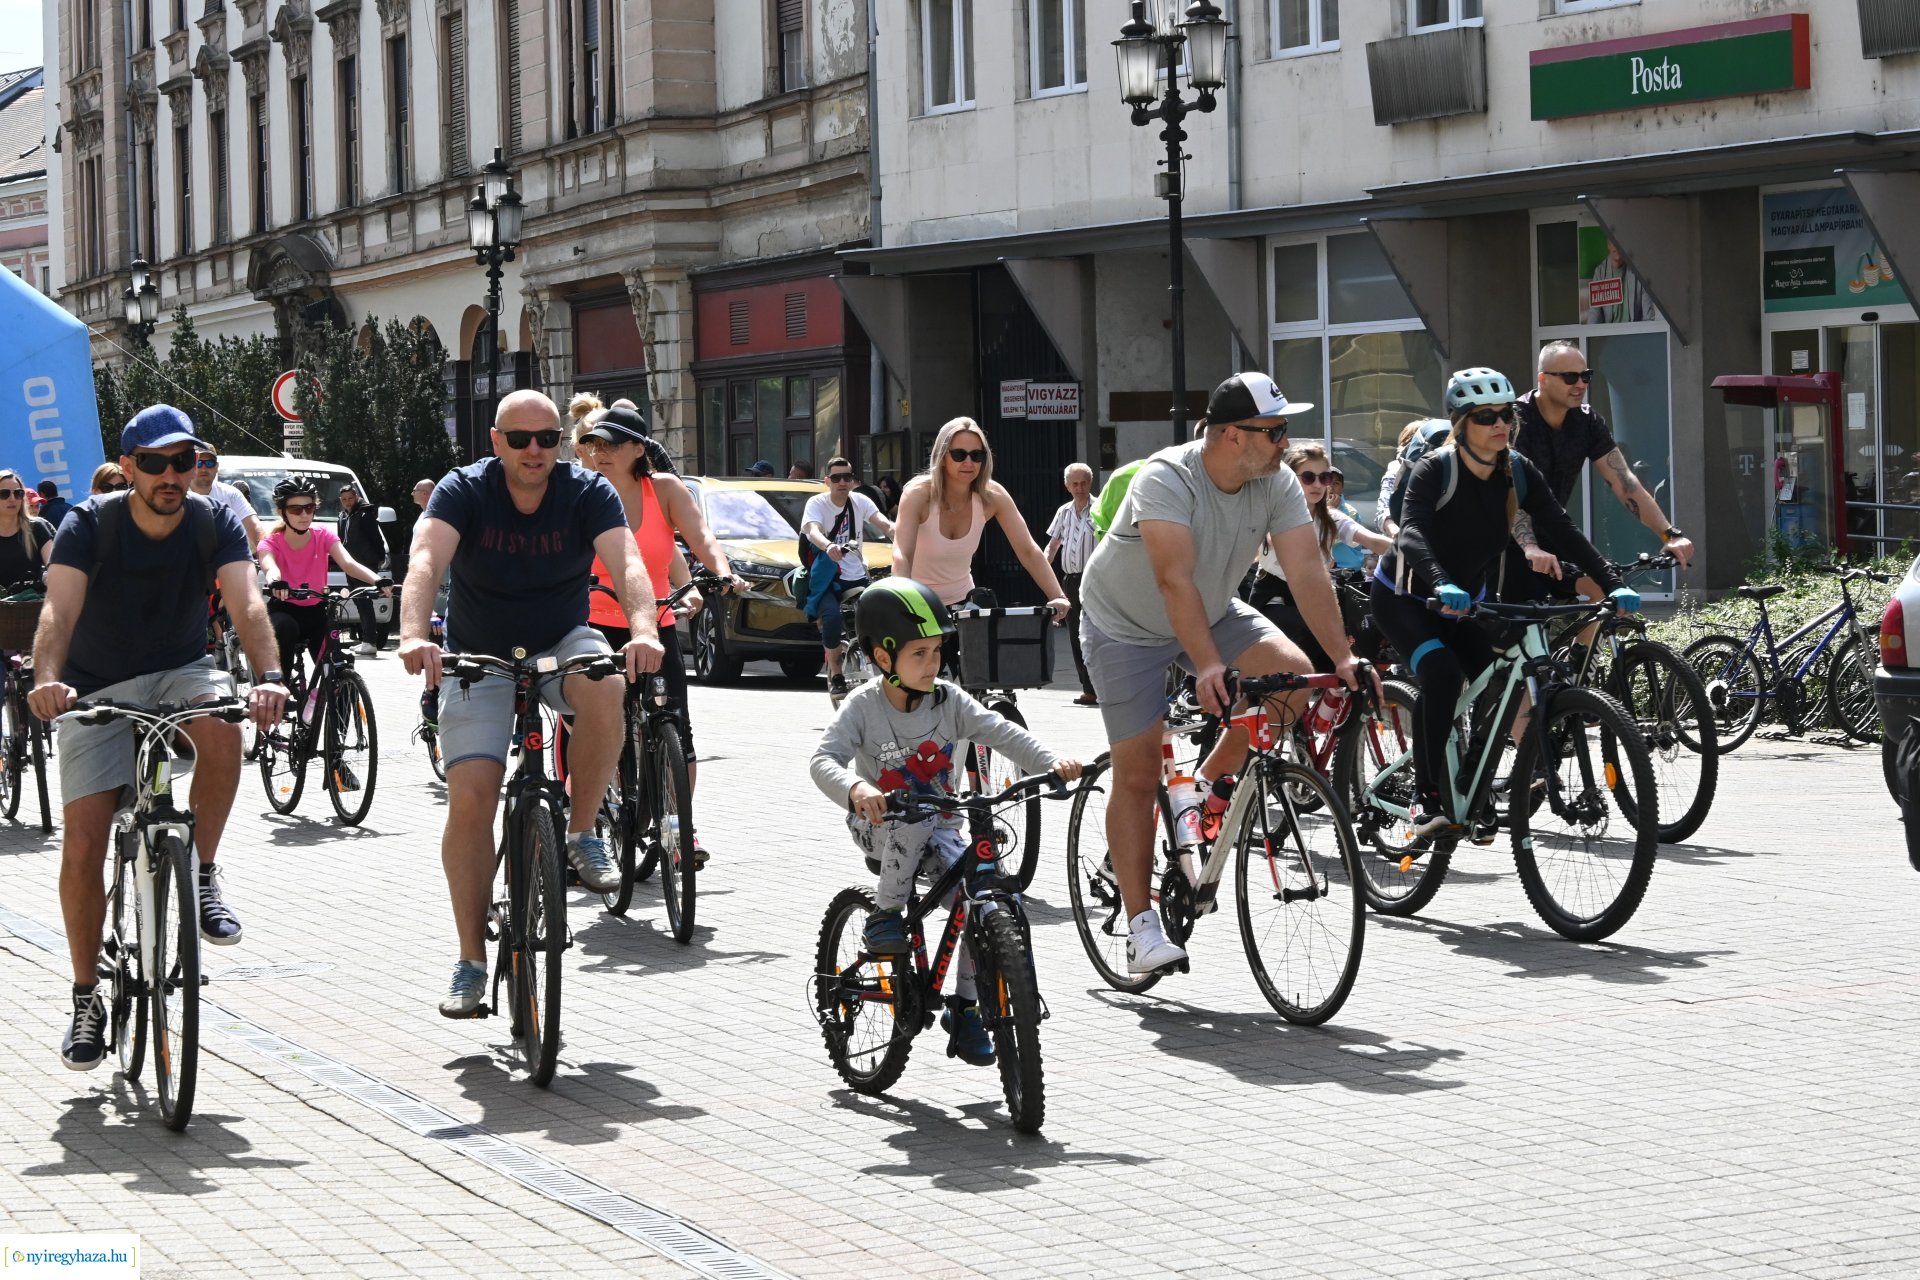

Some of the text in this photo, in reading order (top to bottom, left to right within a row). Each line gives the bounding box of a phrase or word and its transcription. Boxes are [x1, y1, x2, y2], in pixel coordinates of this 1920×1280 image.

[1630, 55, 1683, 95] Posta
[1027, 386, 1077, 400] VIGYÁZZ
[1028, 403, 1077, 415] AUTÓKIJÁRAT
[880, 741, 896, 752] GO
